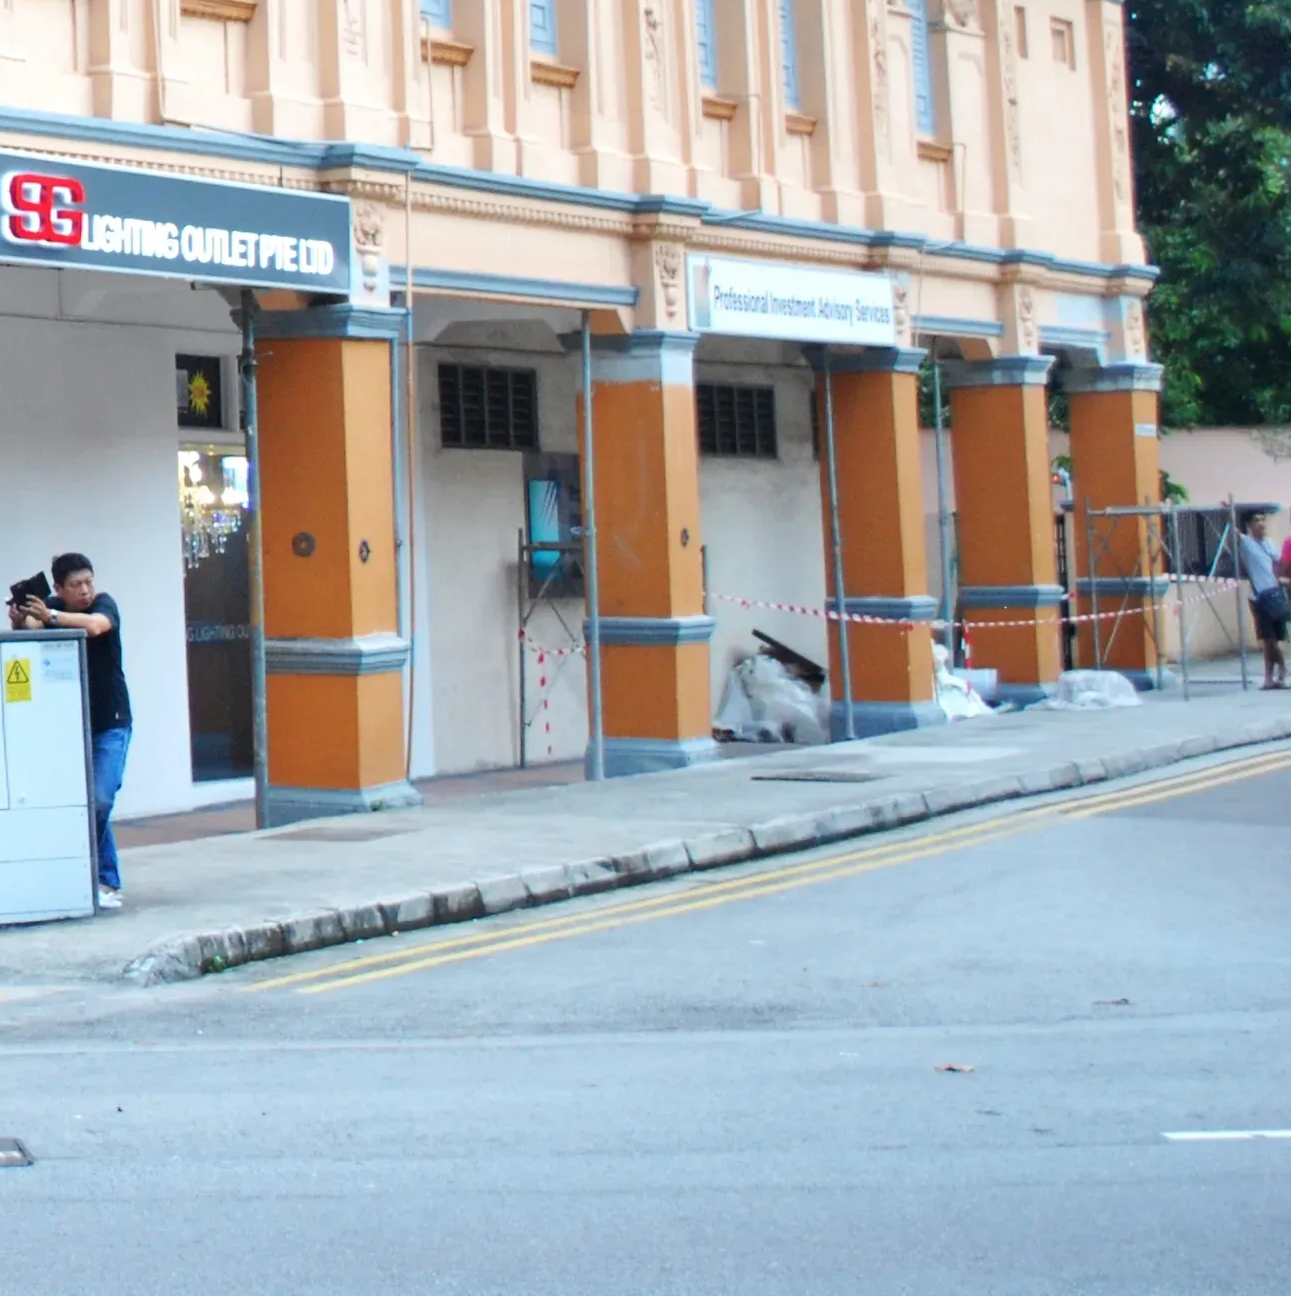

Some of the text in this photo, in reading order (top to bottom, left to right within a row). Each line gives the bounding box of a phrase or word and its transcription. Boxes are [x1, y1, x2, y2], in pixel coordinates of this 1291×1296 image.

[3, 172, 334, 276] SG LIGHTING OUTLET PTE LTD
[713, 285, 891, 326] Professional Investment Advisory Services
